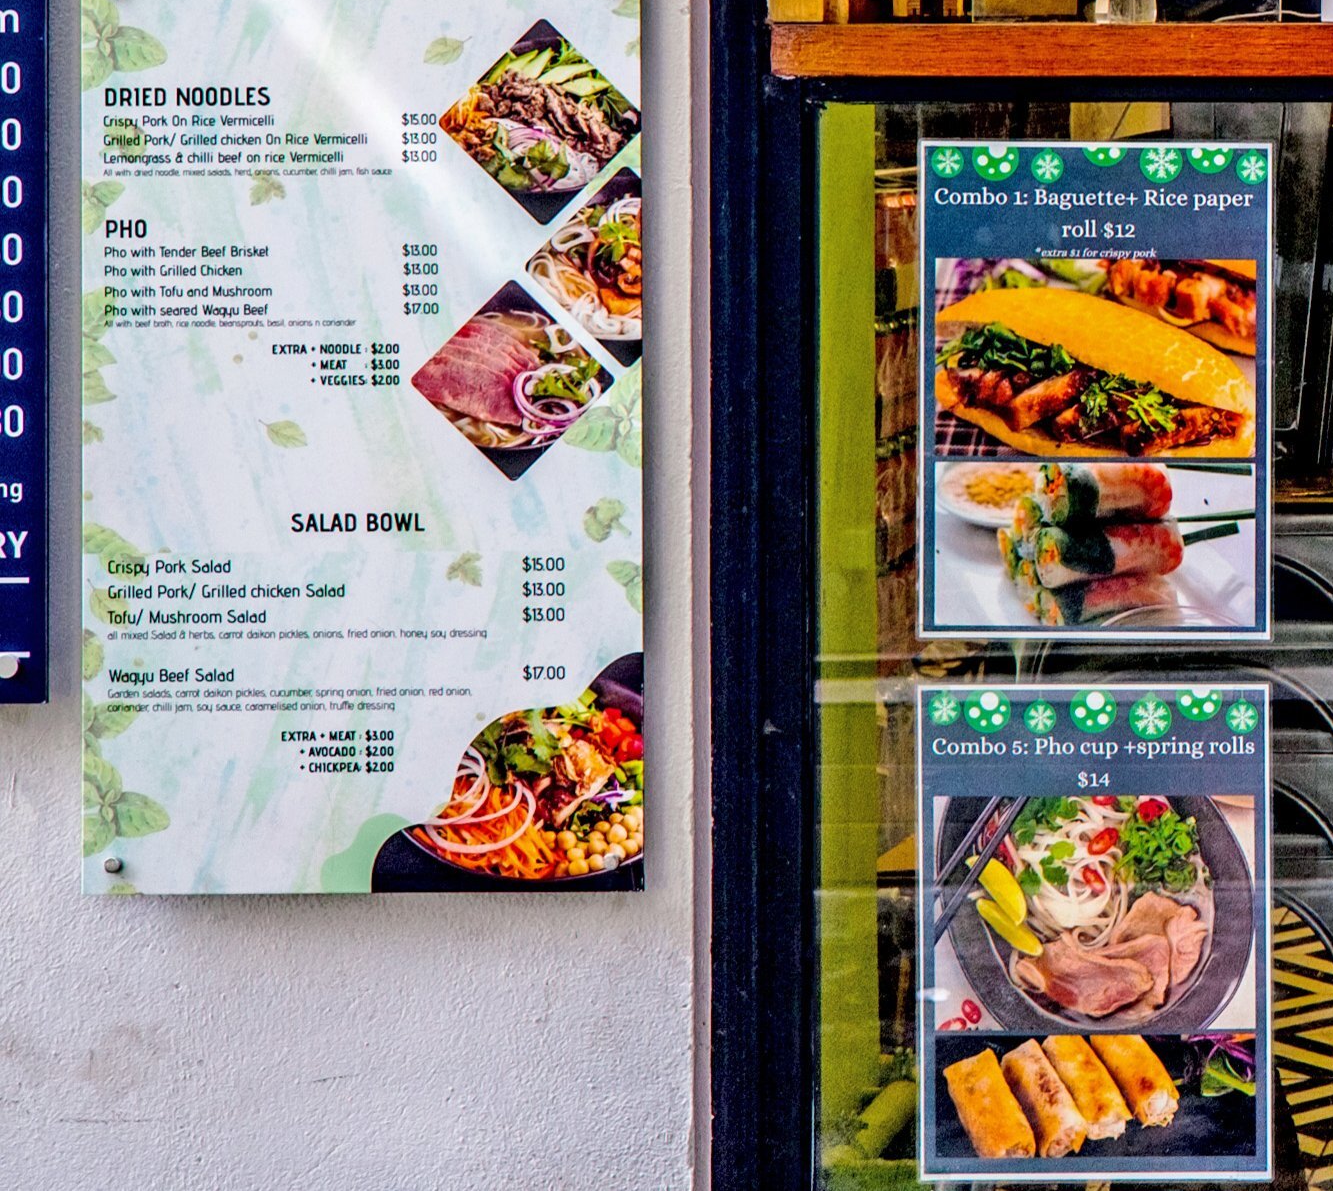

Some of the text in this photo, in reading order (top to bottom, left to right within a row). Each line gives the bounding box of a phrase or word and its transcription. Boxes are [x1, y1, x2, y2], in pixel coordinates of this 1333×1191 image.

[104, 86, 271, 107] DRIED NOODLES
[934, 186, 1254, 212] Combo 1: Baguette+ Rice paper
[105, 218, 147, 239] PHO
[1061, 219, 1136, 240] roll $12
[1069, 248, 1080, 257] $1
[1082, 247, 1098, 259] for
[1099, 247, 1131, 259] crispy
[1132, 247, 1156, 259] pork
[291, 512, 426, 533] SALAD BOWL
[932, 735, 1256, 760] Combo 5: Pho cup +spring rolls
[1077, 770, 1111, 789] $14
